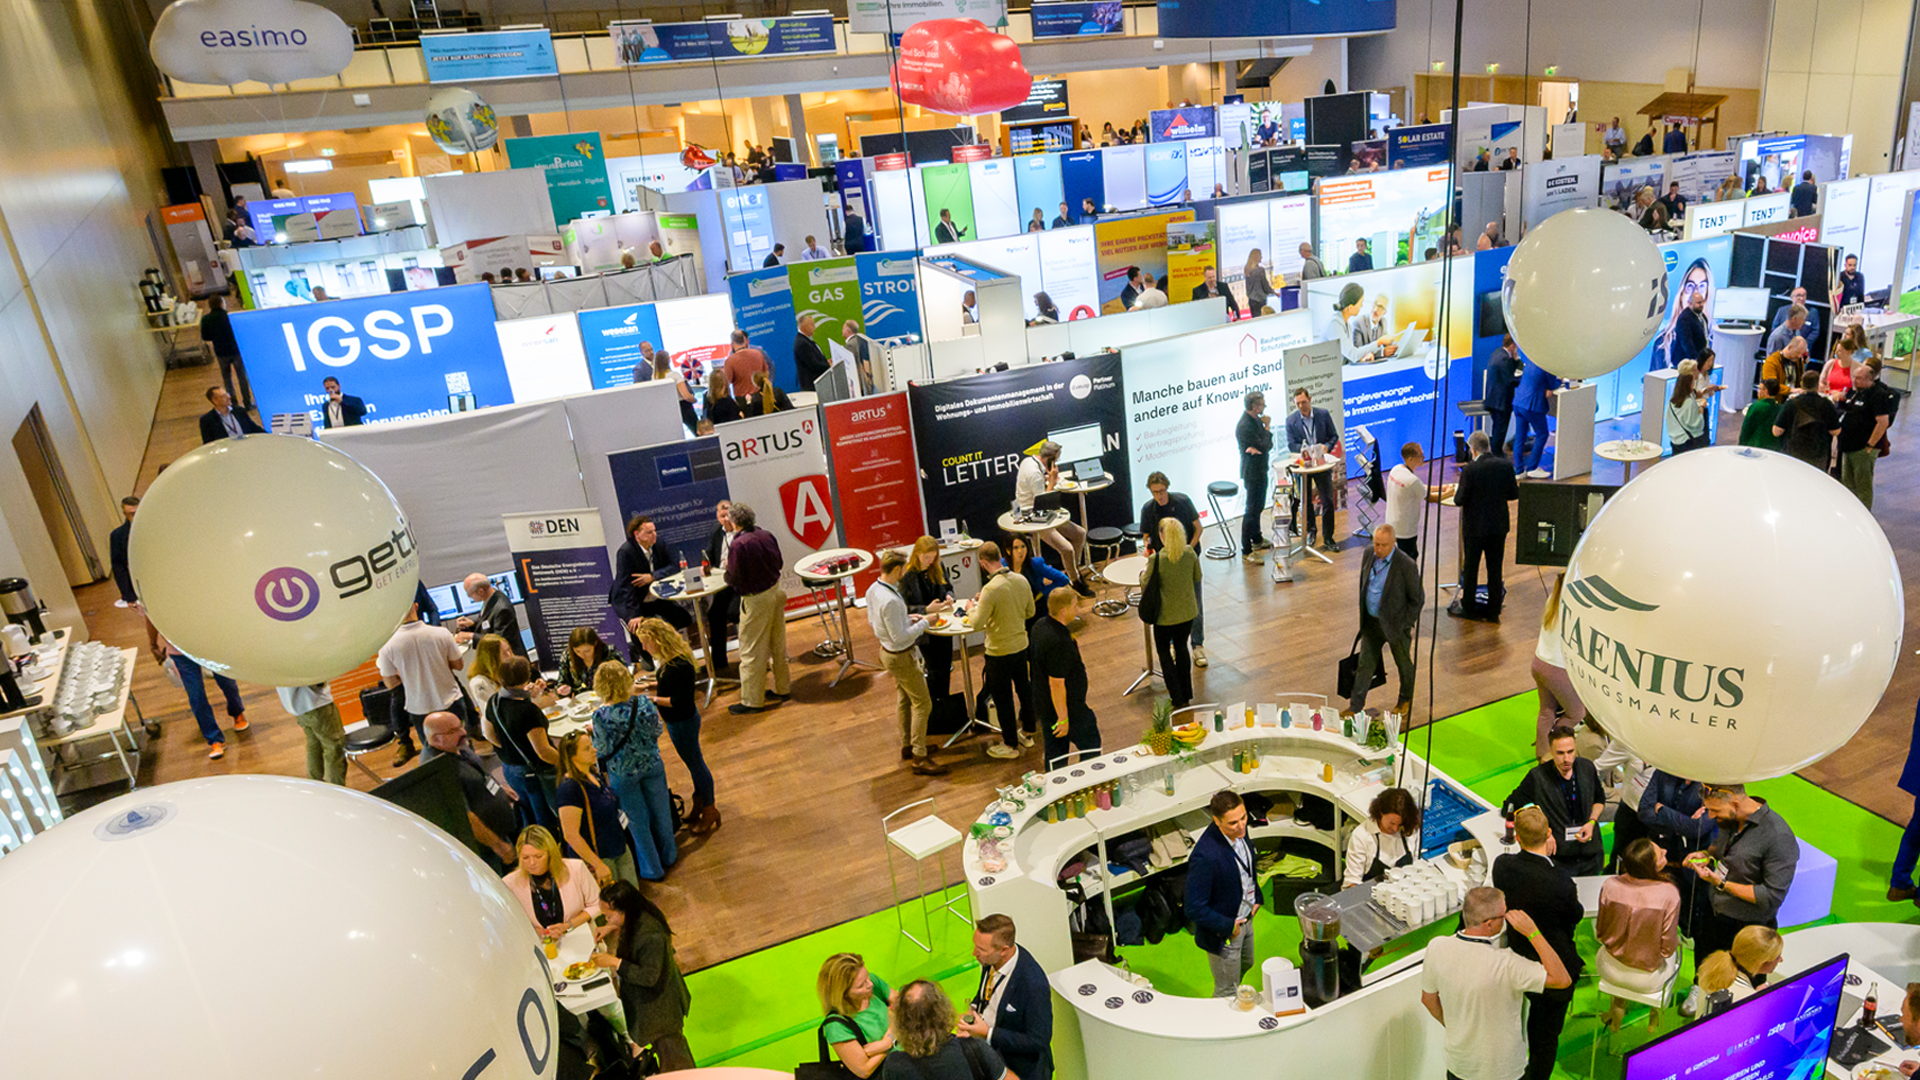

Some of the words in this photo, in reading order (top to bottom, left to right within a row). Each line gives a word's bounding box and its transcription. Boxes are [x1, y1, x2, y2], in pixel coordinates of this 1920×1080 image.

[200, 25, 307, 47] easimo
[1398, 134, 1420, 144] SOLAR
[1422, 132, 1445, 142] ESTATE
[726, 192, 762, 208] enter
[808, 287, 845, 303] GAS
[282, 304, 454, 372] IGSP
[1132, 382, 1184, 404] Manche
[1187, 374, 1226, 390] bauen
[1229, 366, 1249, 382] auf
[935, 401, 962, 412] Digitales
[964, 386, 1045, 408] Dokumentenmanagement
[935, 410, 973, 421] Wohnungs-
[987, 393, 1054, 412] Immobilienwirtschaft
[1133, 402, 1179, 423] andere
[1182, 394, 1203, 412] auf
[1206, 380, 1273, 406] Know-how.
[942, 453, 973, 467] COUNT
[942, 454, 1020, 487] LETTER
[546, 518, 580, 534] DEN
[375, 572, 393, 590] GET
